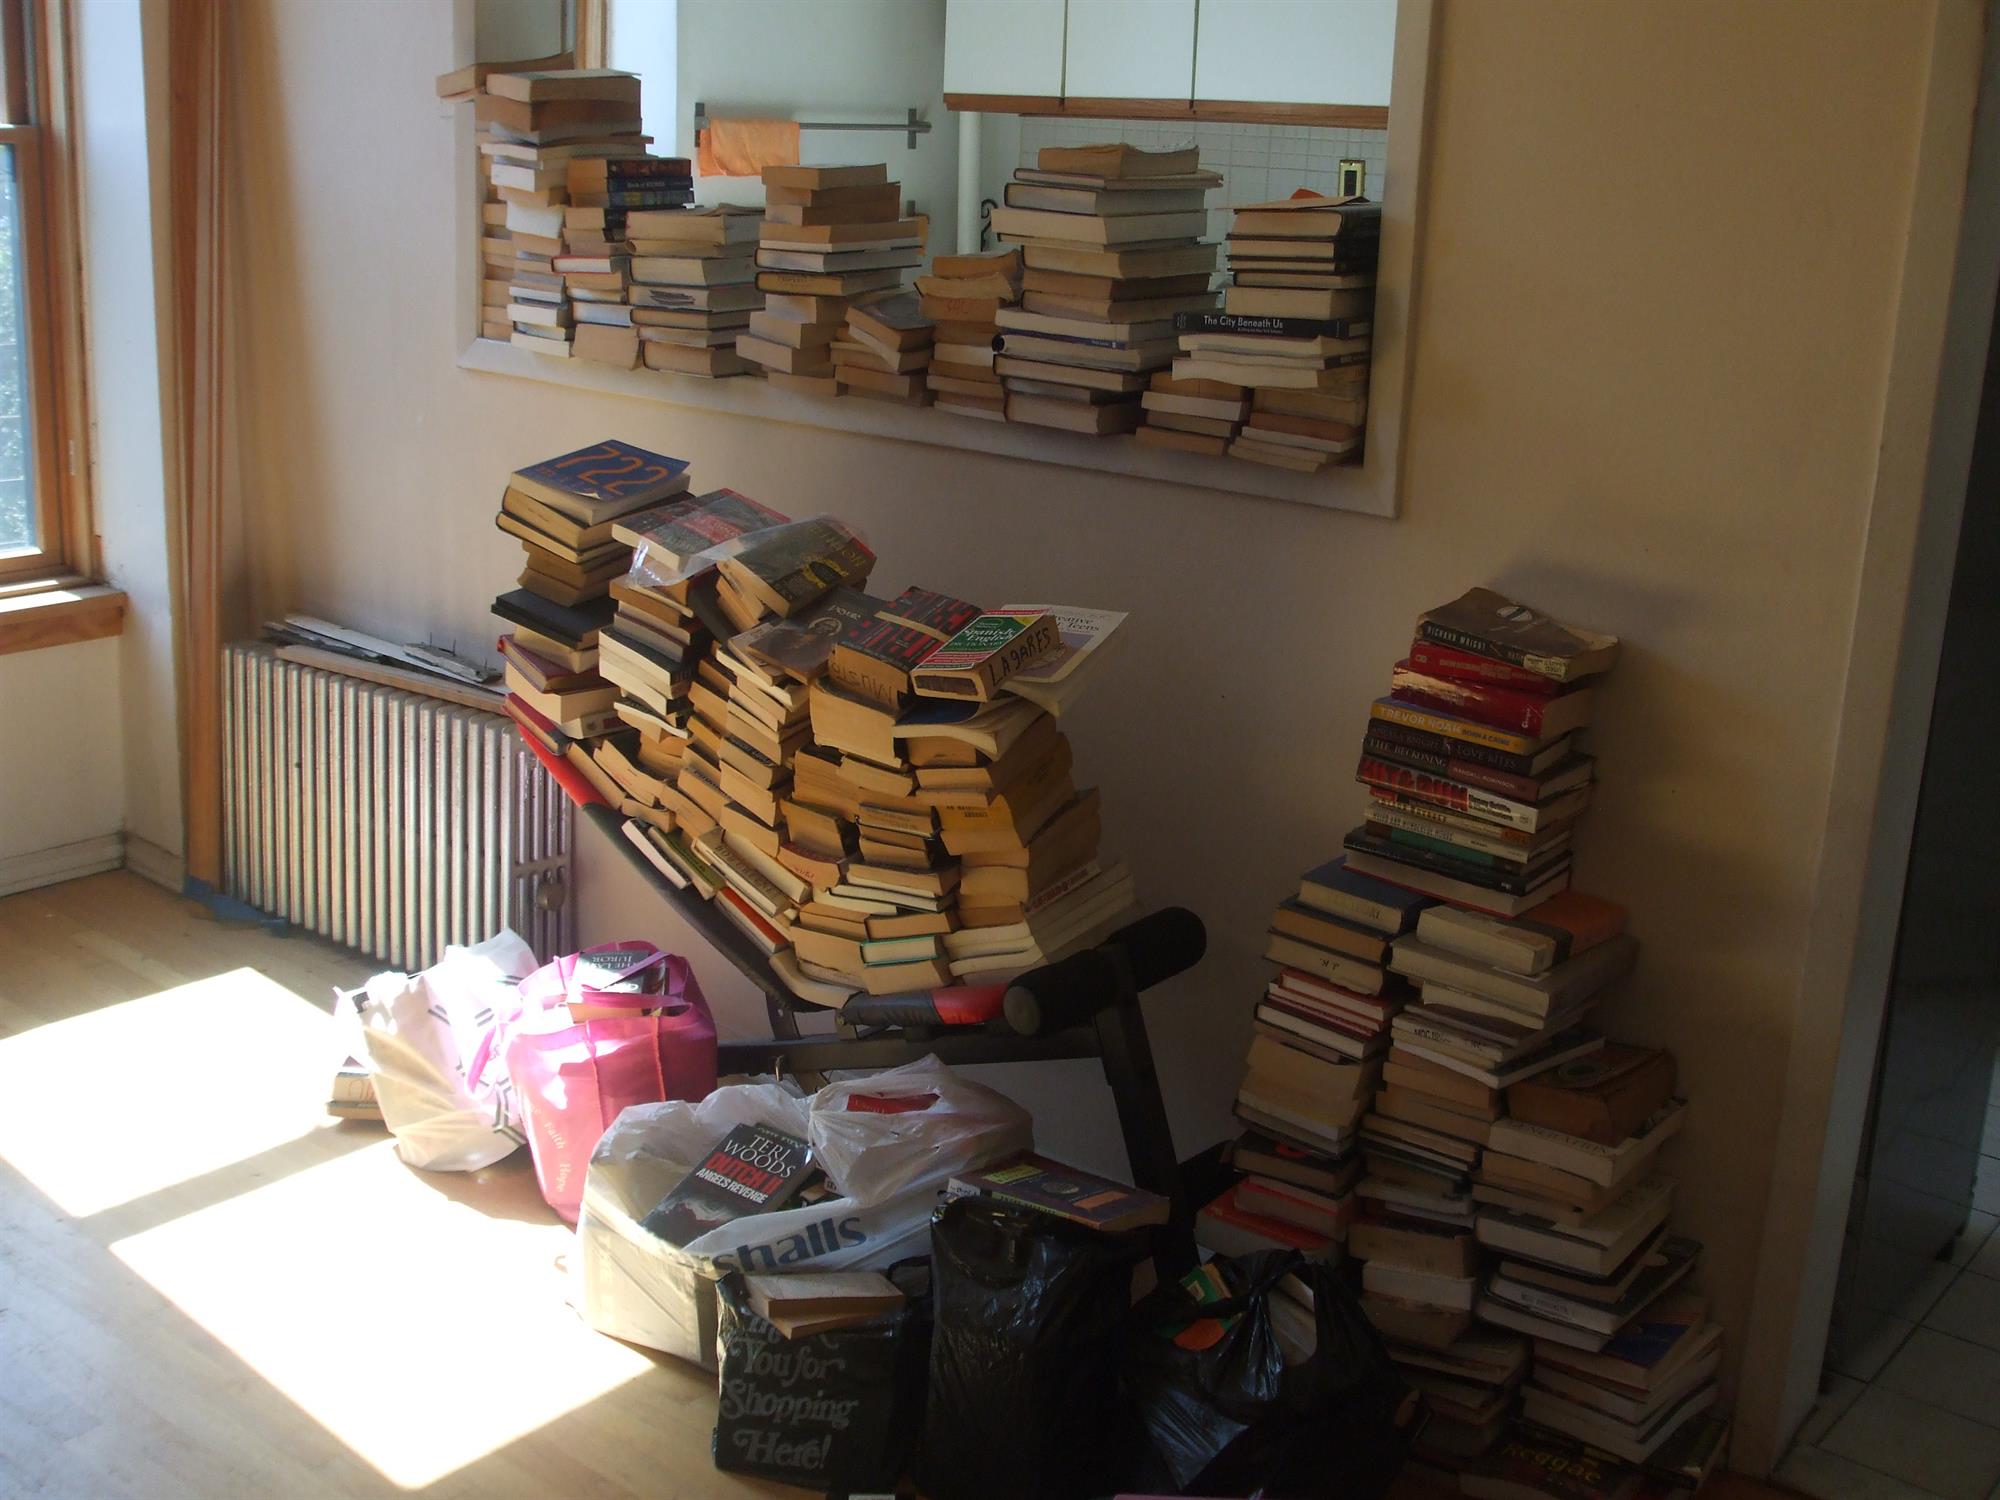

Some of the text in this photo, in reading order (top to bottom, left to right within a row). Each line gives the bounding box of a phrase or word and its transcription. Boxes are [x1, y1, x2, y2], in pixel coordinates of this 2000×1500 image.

[1204, 315, 1283, 329] The City Beneath Us
[555, 446, 669, 496] 722
[1427, 625, 1457, 642] RICHARD
[1460, 635, 1487, 650] WRIGHT
[1381, 706, 1425, 726] TREVOR
[1428, 719, 1463, 735] NOAH
[724, 1139, 796, 1178] WOODS
[749, 1134, 791, 1161] TERI
[705, 1152, 770, 1189] DUTCH
[727, 1180, 769, 1204] REVENGE
[728, 1337, 846, 1388] You for
[720, 1379, 860, 1430] Shopping
[733, 1429, 832, 1470] Here!
